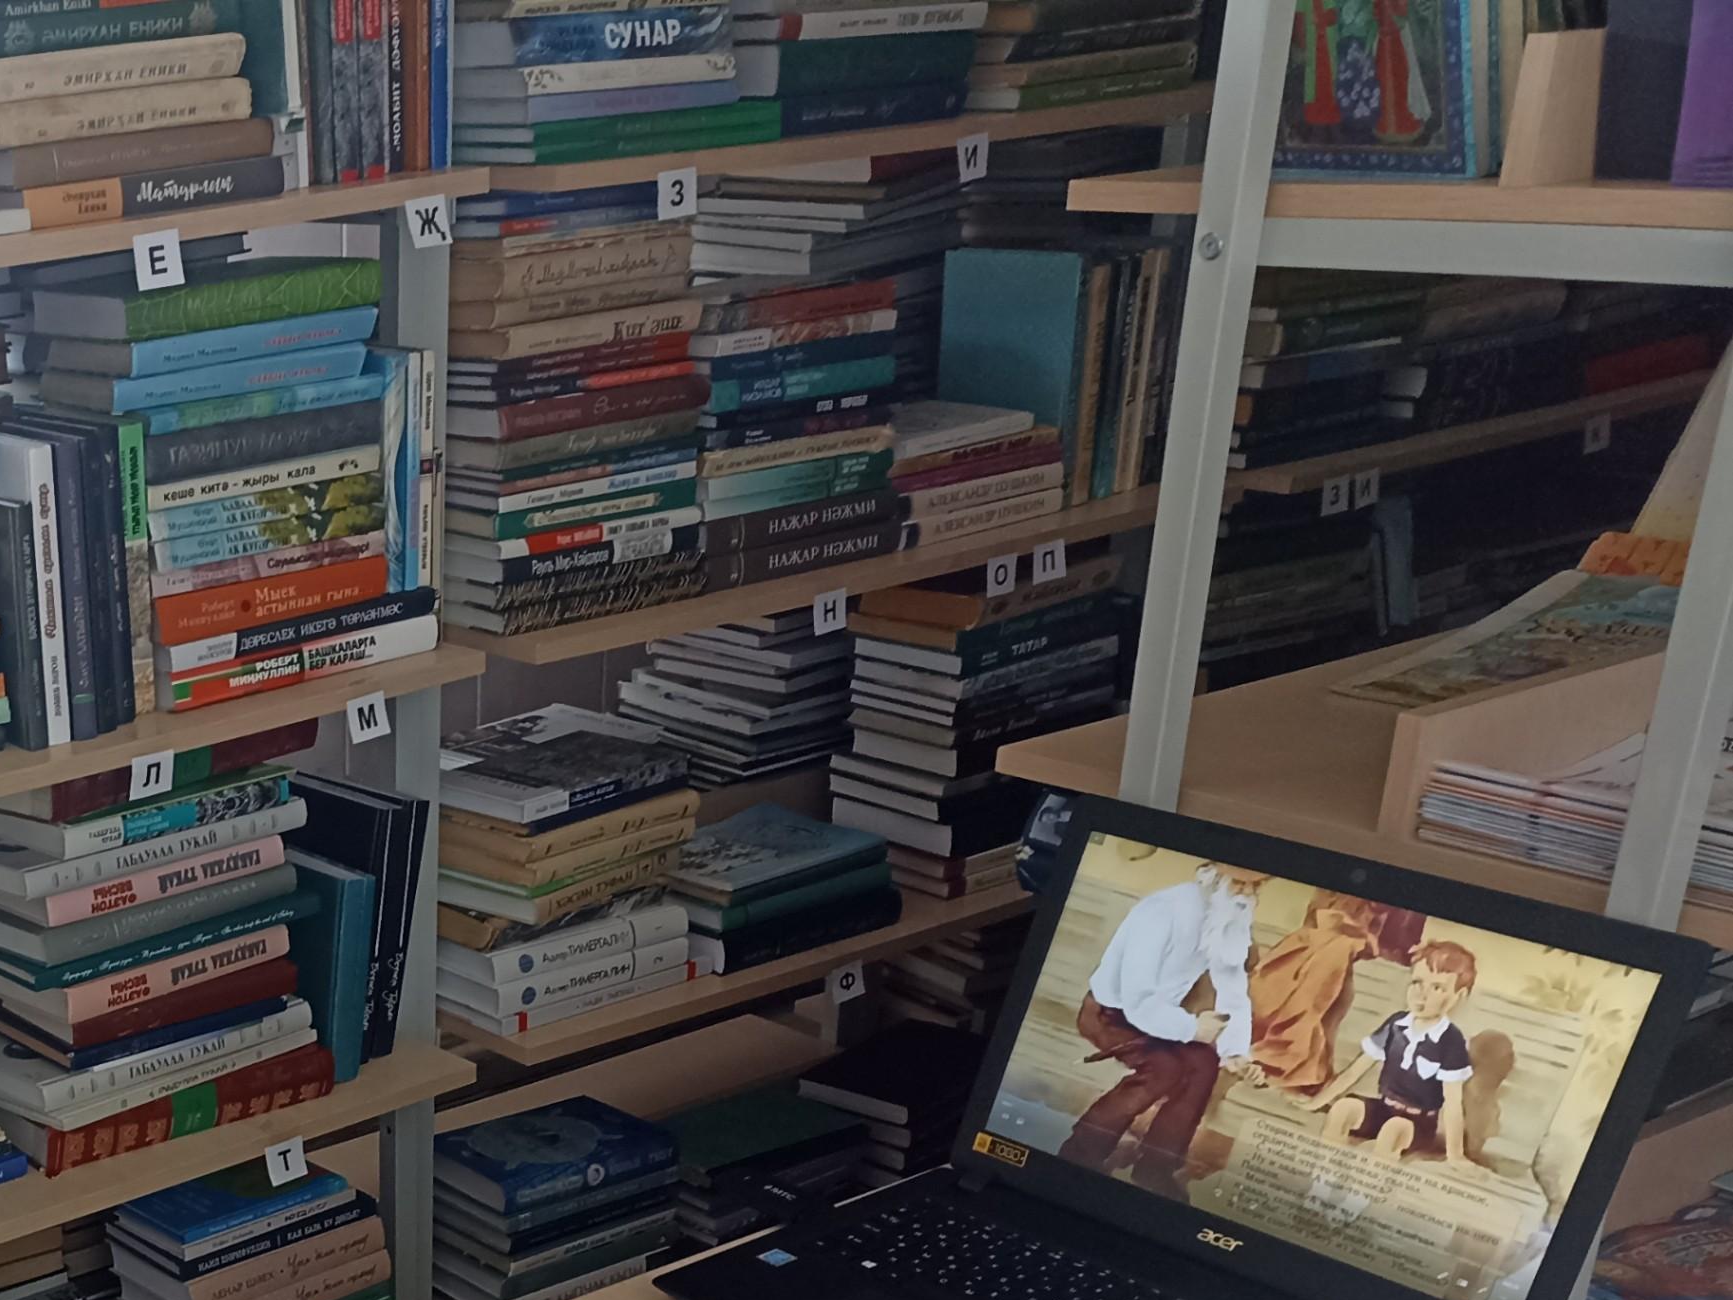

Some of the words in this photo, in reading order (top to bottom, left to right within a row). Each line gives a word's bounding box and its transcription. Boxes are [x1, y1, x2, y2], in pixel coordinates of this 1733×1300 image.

[129, 18, 184, 36] ЕНИКИ
[604, 18, 681, 49] СУНАР
[148, 246, 168, 275] Е
[163, 487, 194, 503] кеше
[287, 464, 316, 481] кала
[1041, 549, 1057, 573] П
[994, 563, 1009, 586] О
[255, 585, 297, 603] Мыек
[823, 599, 837, 623] Н
[300, 617, 336, 637] ИКЕГӘ
[308, 635, 376, 660] БАШКАЛАРГА
[256, 653, 299, 672] РОБЕРТ
[309, 658, 329, 672] БЕР
[357, 704, 378, 731] М
[143, 763, 161, 787] Л
[116, 846, 174, 870] ГАБДУЛЛА
[179, 833, 218, 854] ТУКАЙ
[202, 849, 262, 876] ГАБДУЛЛА
[94, 880, 133, 899] ВЕСНЫ
[158, 864, 198, 893] ТУКАЙ
[91, 893, 137, 914] ФАЭТОН
[111, 973, 148, 994] ВЕСНЫ
[171, 957, 209, 986] ТУКАЙ
[108, 985, 151, 1009] ФАЭТОН
[128, 1053, 185, 1079] ГАБДУЛЛА
[190, 1038, 227, 1060] ТУКАЙ
[277, 1148, 292, 1172] Т
[1195, 1226, 1245, 1253] acer
